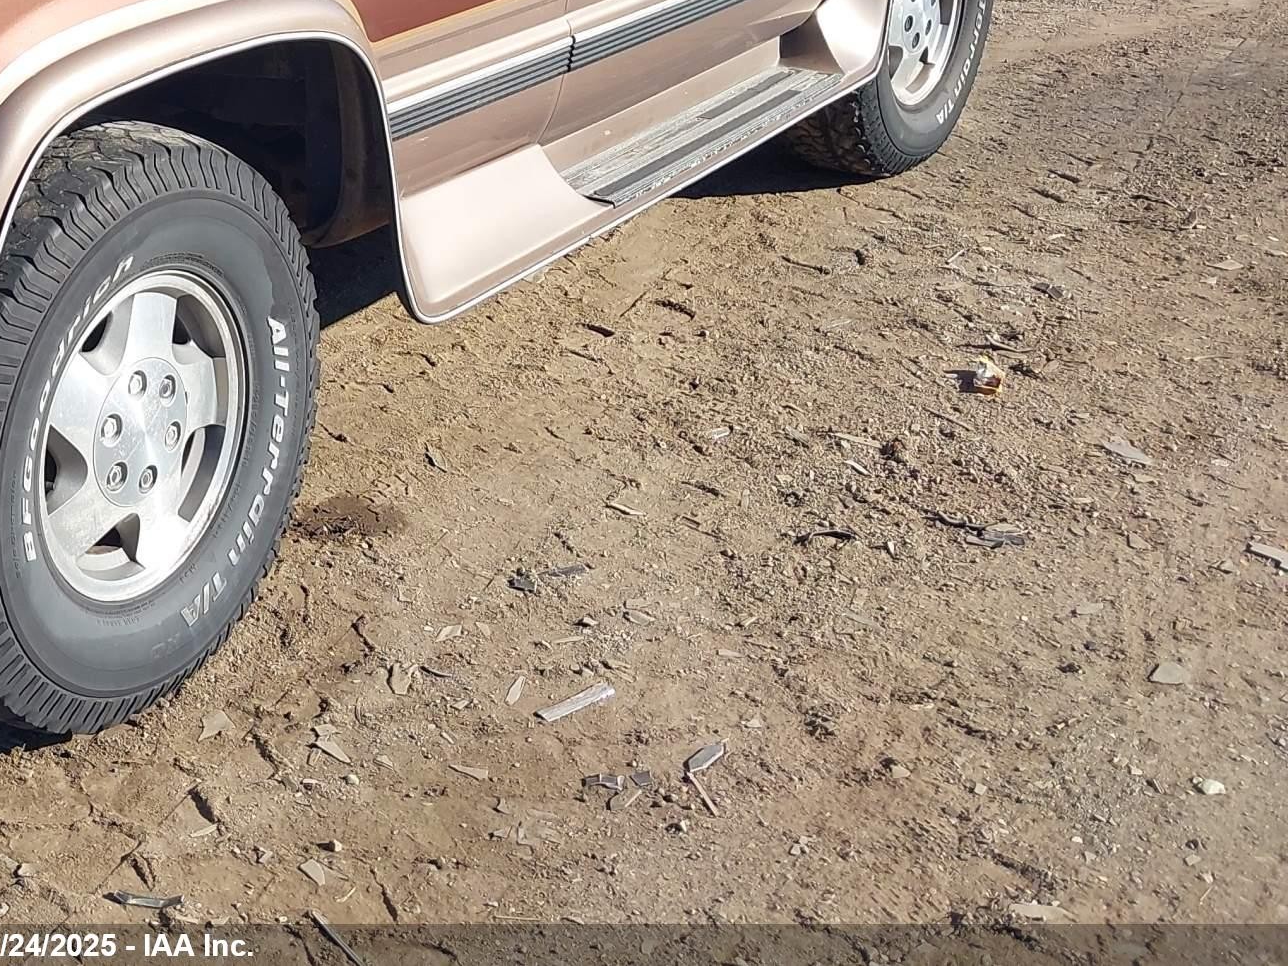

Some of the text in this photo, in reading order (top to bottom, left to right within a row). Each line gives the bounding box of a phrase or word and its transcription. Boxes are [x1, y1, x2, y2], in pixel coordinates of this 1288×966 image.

[21, 253, 134, 562] BFGoodrich
[227, 316, 290, 567] All-Terrain
[180, 571, 228, 627] T/A
